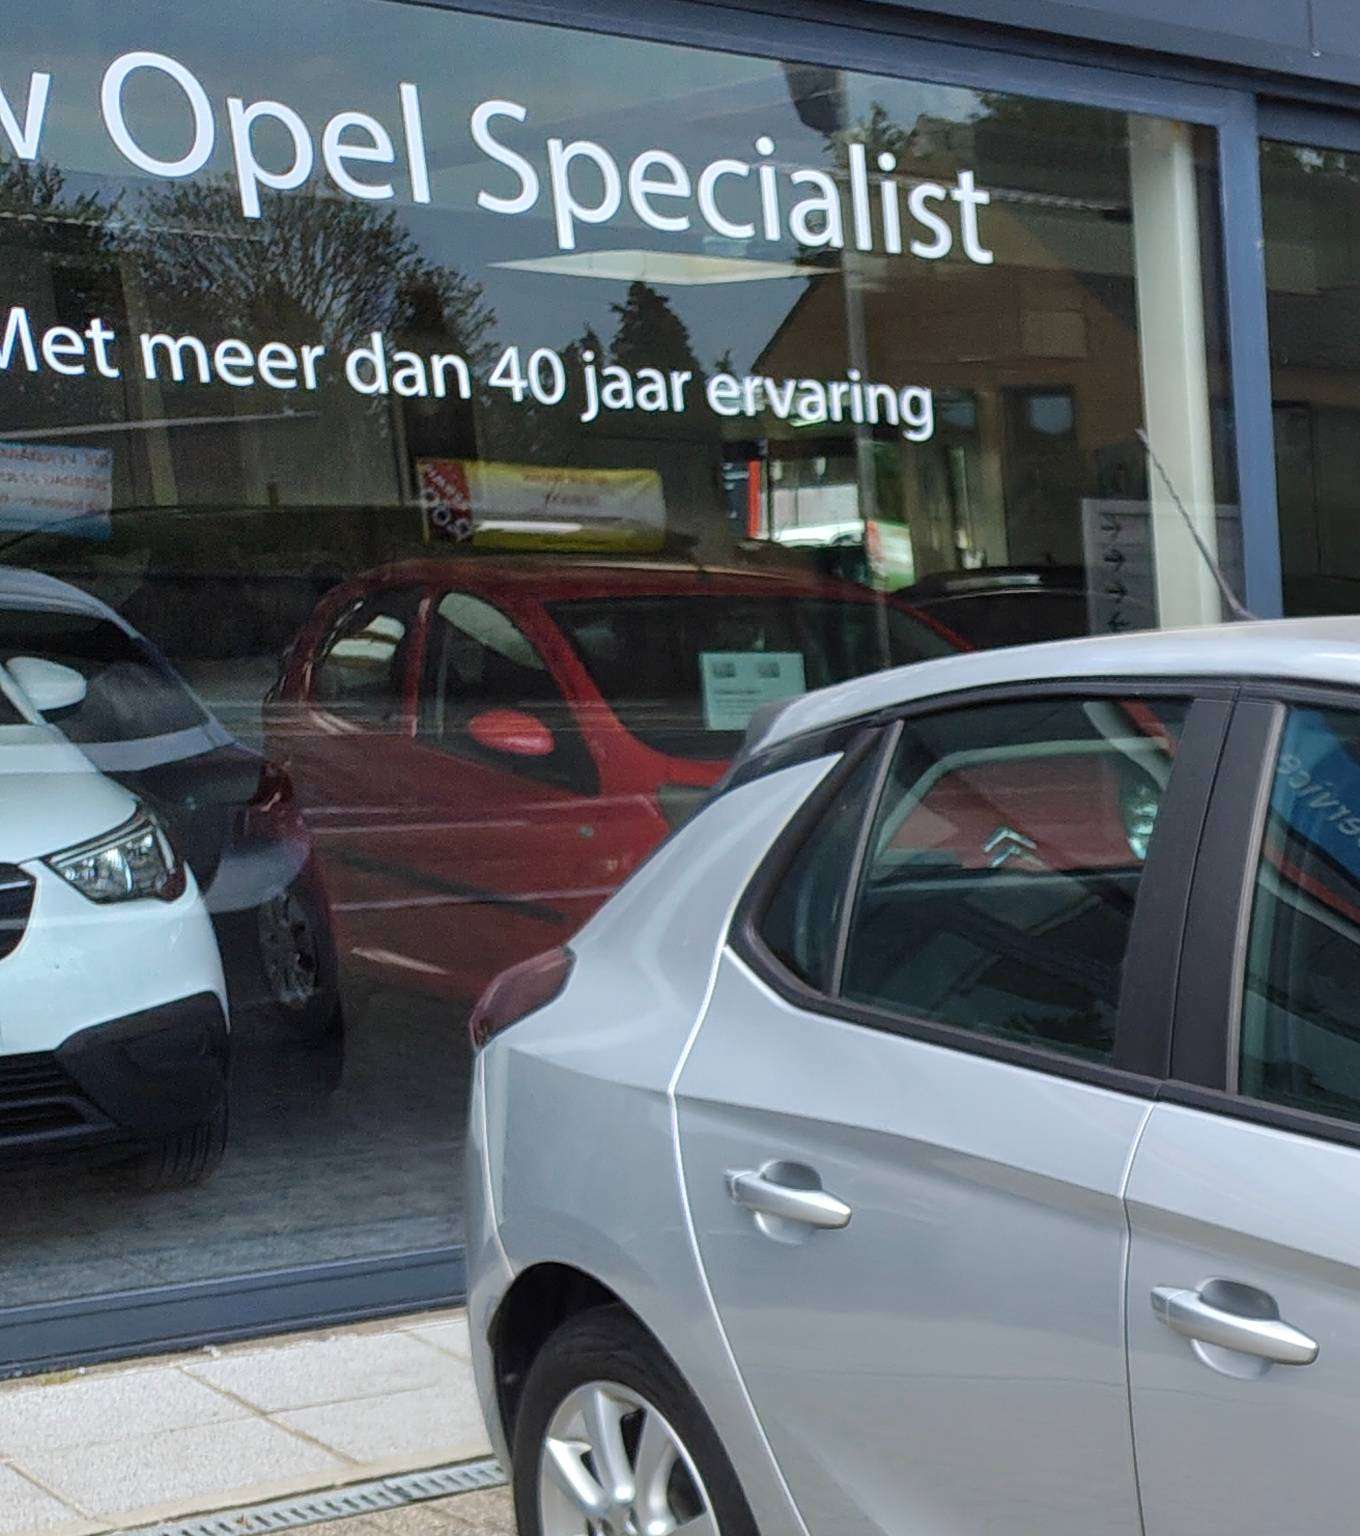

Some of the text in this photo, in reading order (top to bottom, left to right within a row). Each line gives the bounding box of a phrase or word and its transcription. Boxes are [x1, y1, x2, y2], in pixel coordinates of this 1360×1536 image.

[101, 51, 430, 218] Opel
[471, 99, 994, 264] Specialist
[0, 306, 934, 442] Met meer dan 40 jaar ervaring
